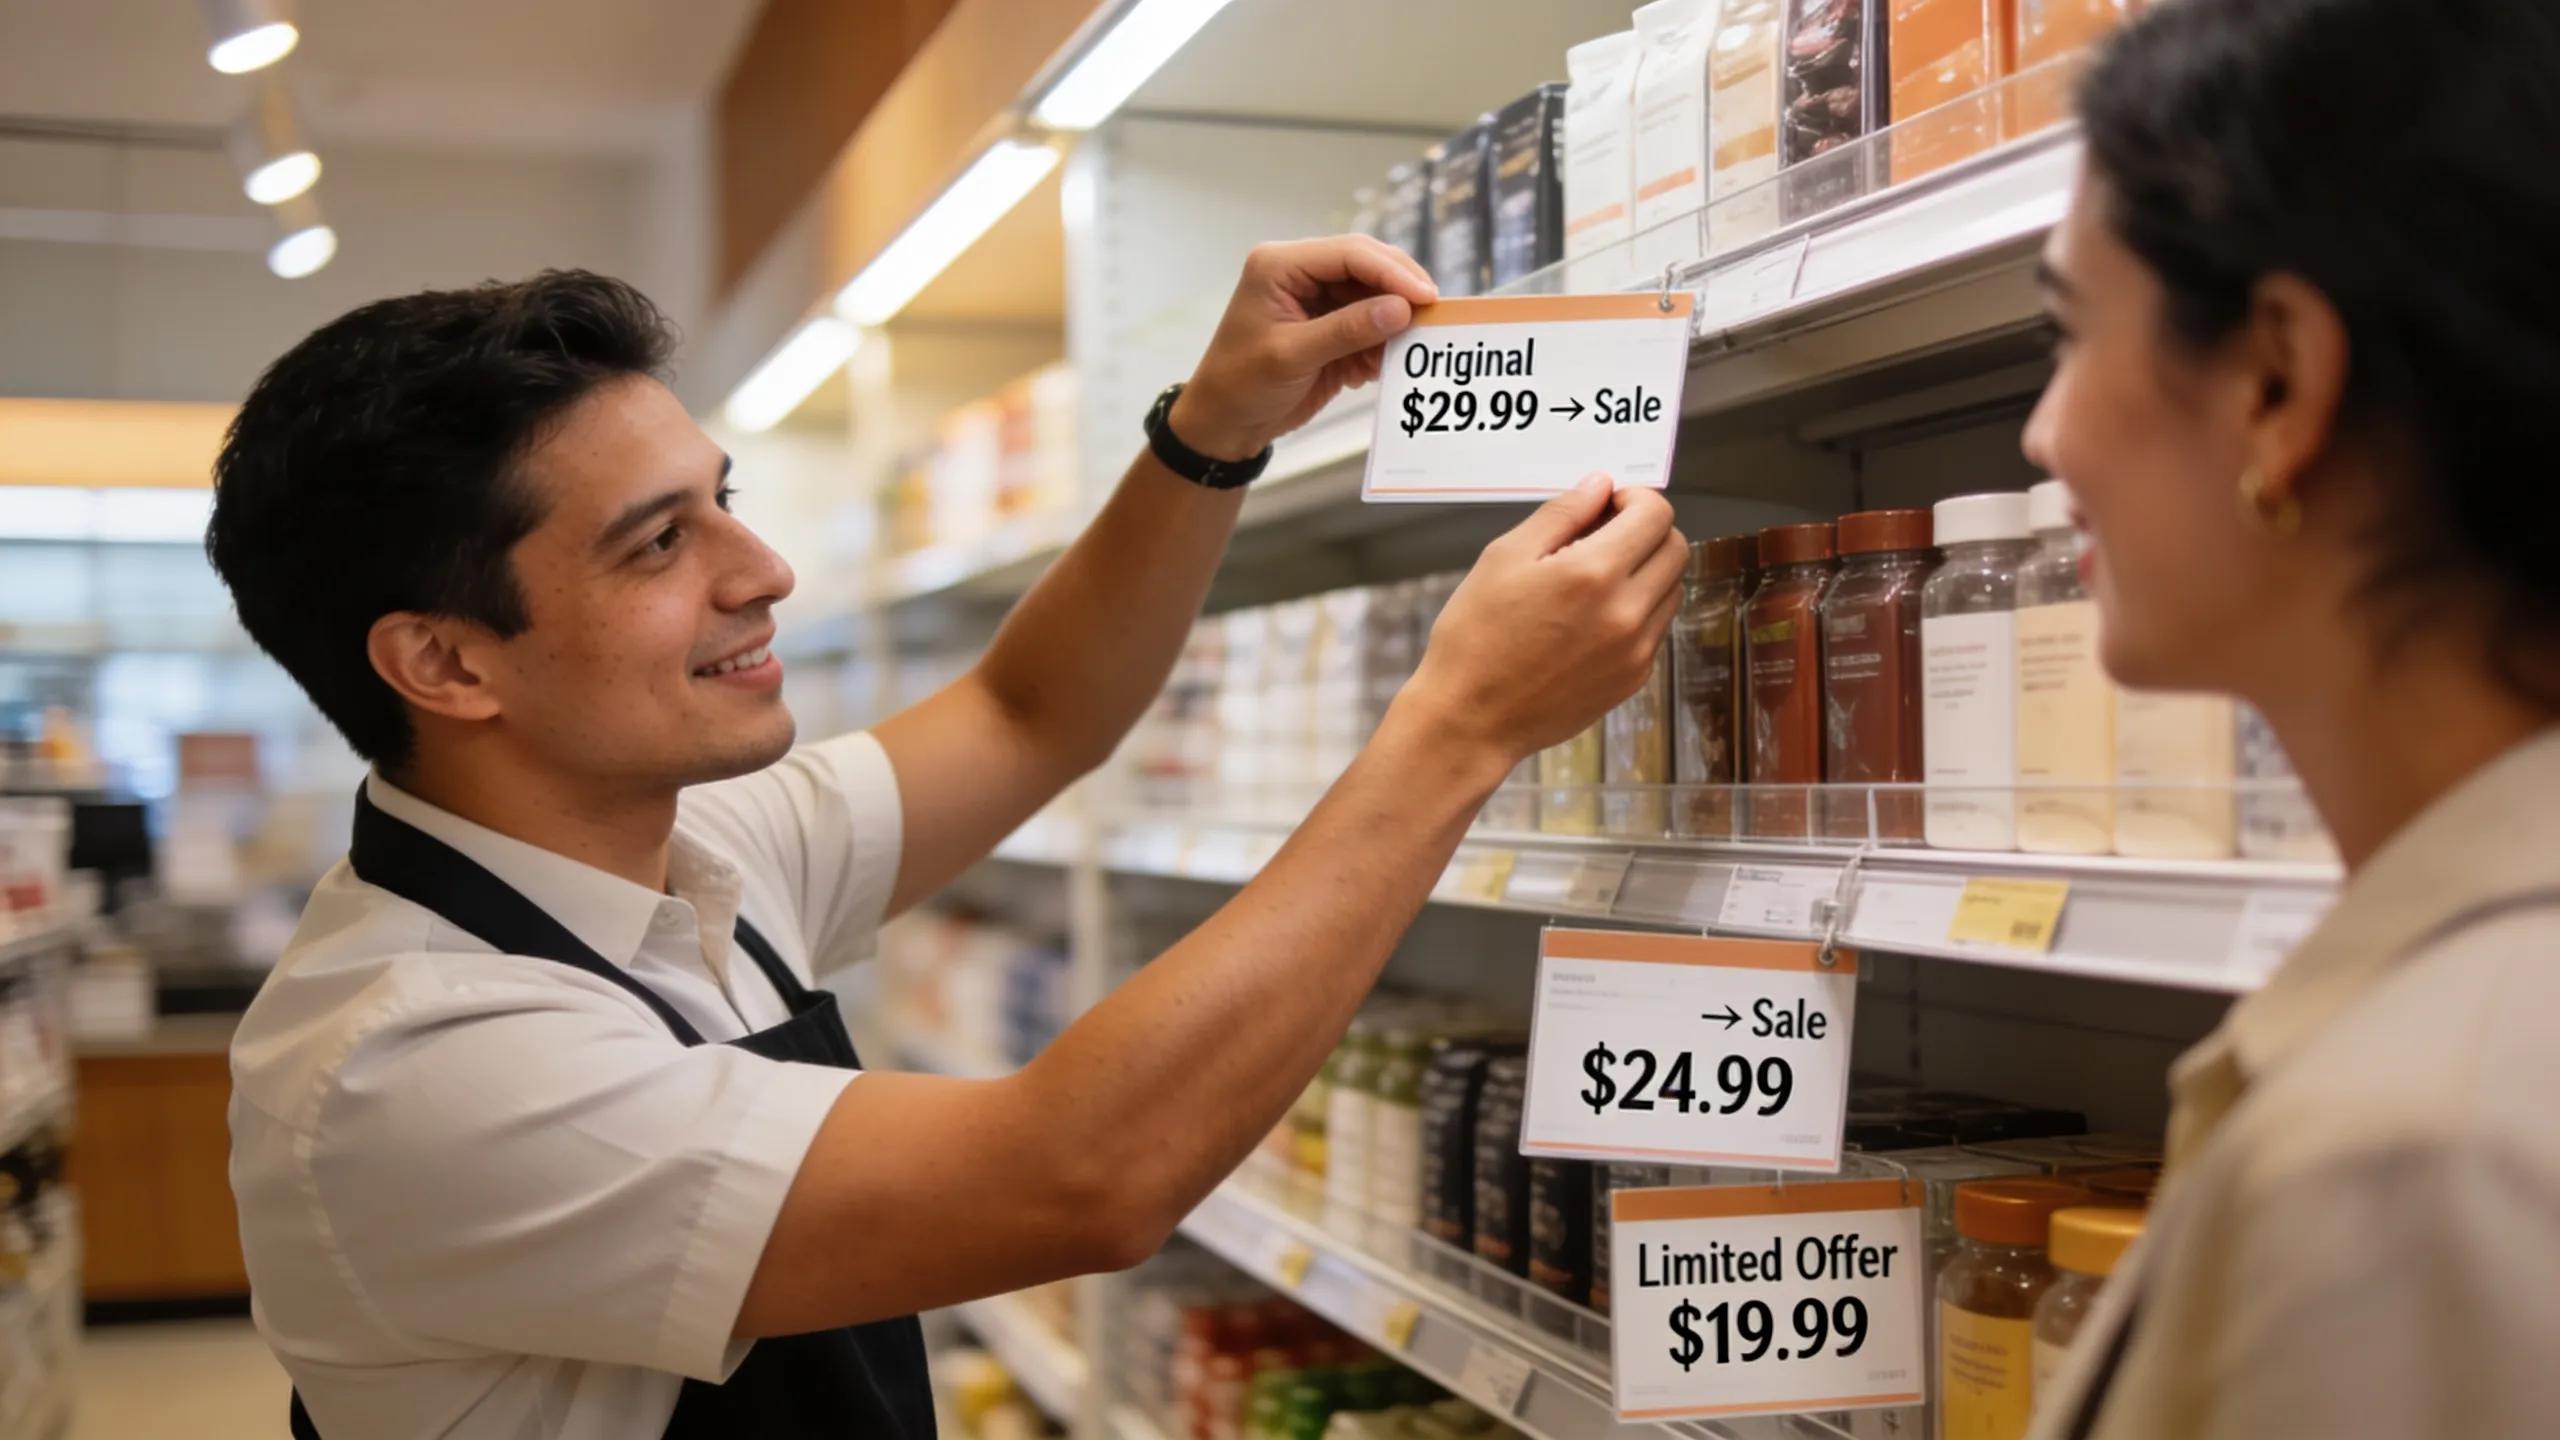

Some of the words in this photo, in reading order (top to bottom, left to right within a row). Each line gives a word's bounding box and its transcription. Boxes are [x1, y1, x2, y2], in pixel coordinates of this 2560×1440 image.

[1404, 337, 1534, 385] Original
[1400, 386, 1538, 438] $29.99
[1593, 385, 1660, 424] Sale
[1751, 997, 1827, 1039] Sale
[1580, 1040, 1793, 1116] $24.99
[1638, 1236, 1782, 1287] Limited
[1795, 1232, 1898, 1280] Offer
[1668, 1295, 1868, 1372] $19.99
